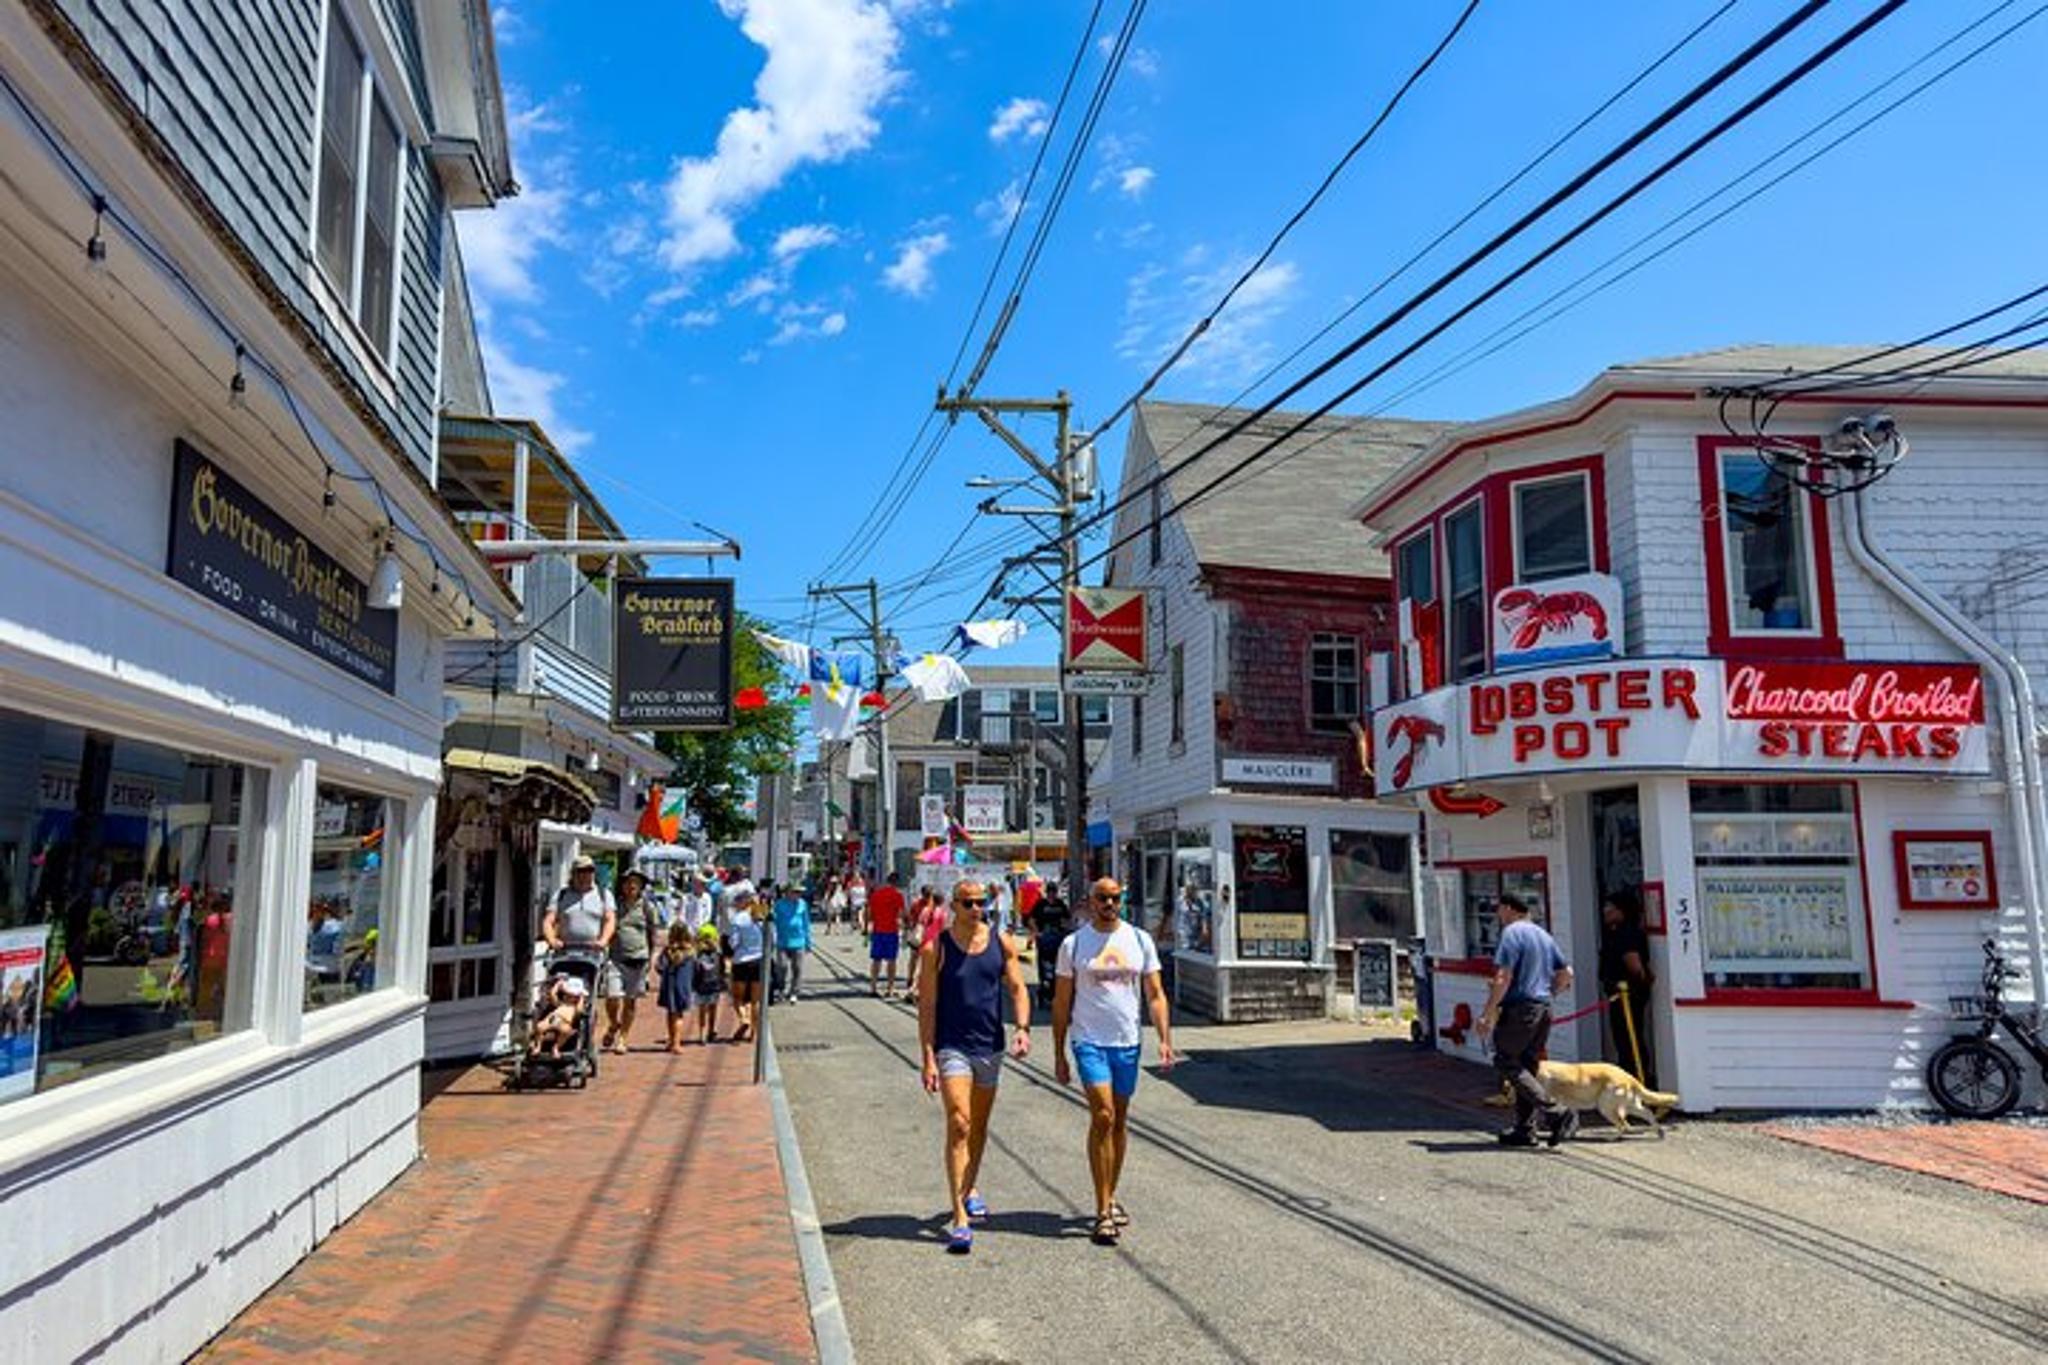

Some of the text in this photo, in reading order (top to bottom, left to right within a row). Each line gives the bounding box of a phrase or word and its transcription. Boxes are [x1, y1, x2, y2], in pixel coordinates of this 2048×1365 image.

[191, 465, 291, 577] Governor
[203, 566, 242, 601] FOOD
[259, 600, 298, 634] DRINK
[625, 592, 716, 612] Governor
[639, 614, 723, 635] Bradford
[620, 705, 726, 717] ENTERTAINMENT
[629, 691, 717, 703] FOOD DRINK
[1470, 668, 1701, 735] LOBSTER
[1727, 665, 1980, 720] Charcoal Broiled
[1513, 717, 1630, 762] POT
[1759, 721, 1961, 759] STEAKS
